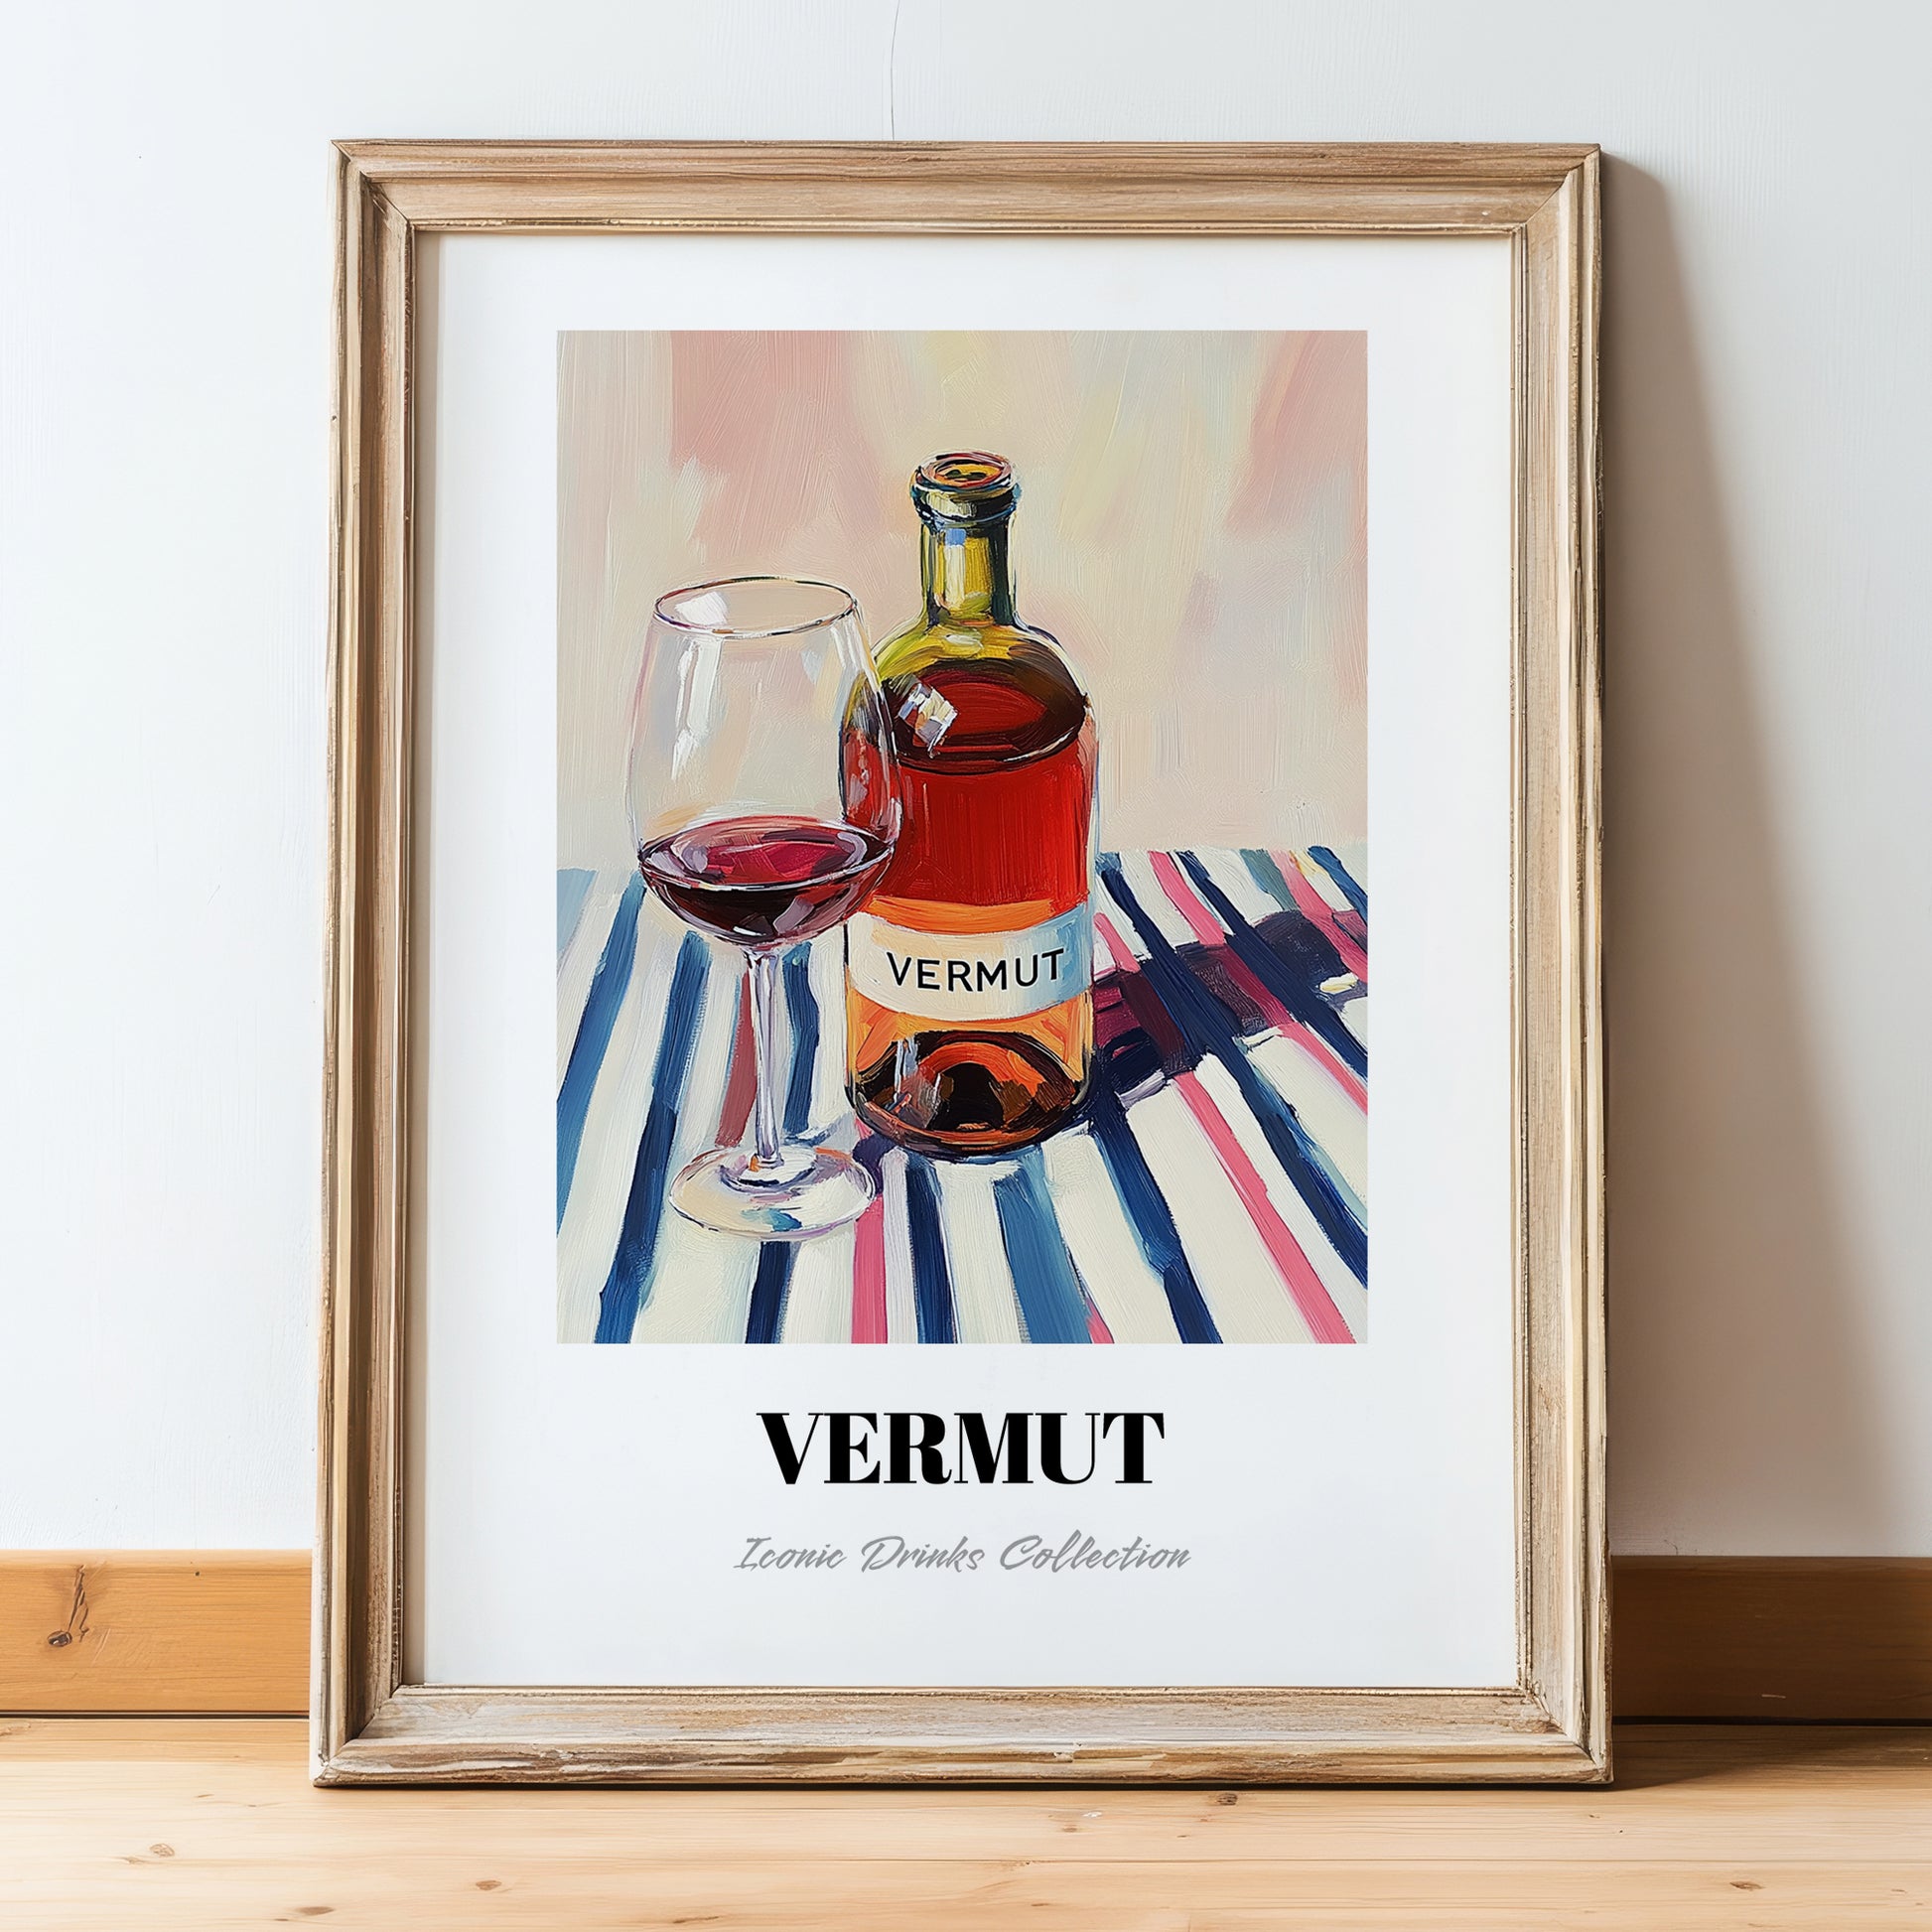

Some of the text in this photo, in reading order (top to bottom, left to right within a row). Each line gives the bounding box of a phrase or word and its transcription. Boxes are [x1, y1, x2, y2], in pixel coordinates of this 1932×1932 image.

[887, 948, 1064, 993] VERMUT
[756, 1412, 1165, 1484] VERMUT
[734, 1529, 1191, 1574] Iconic Drinks Collection
